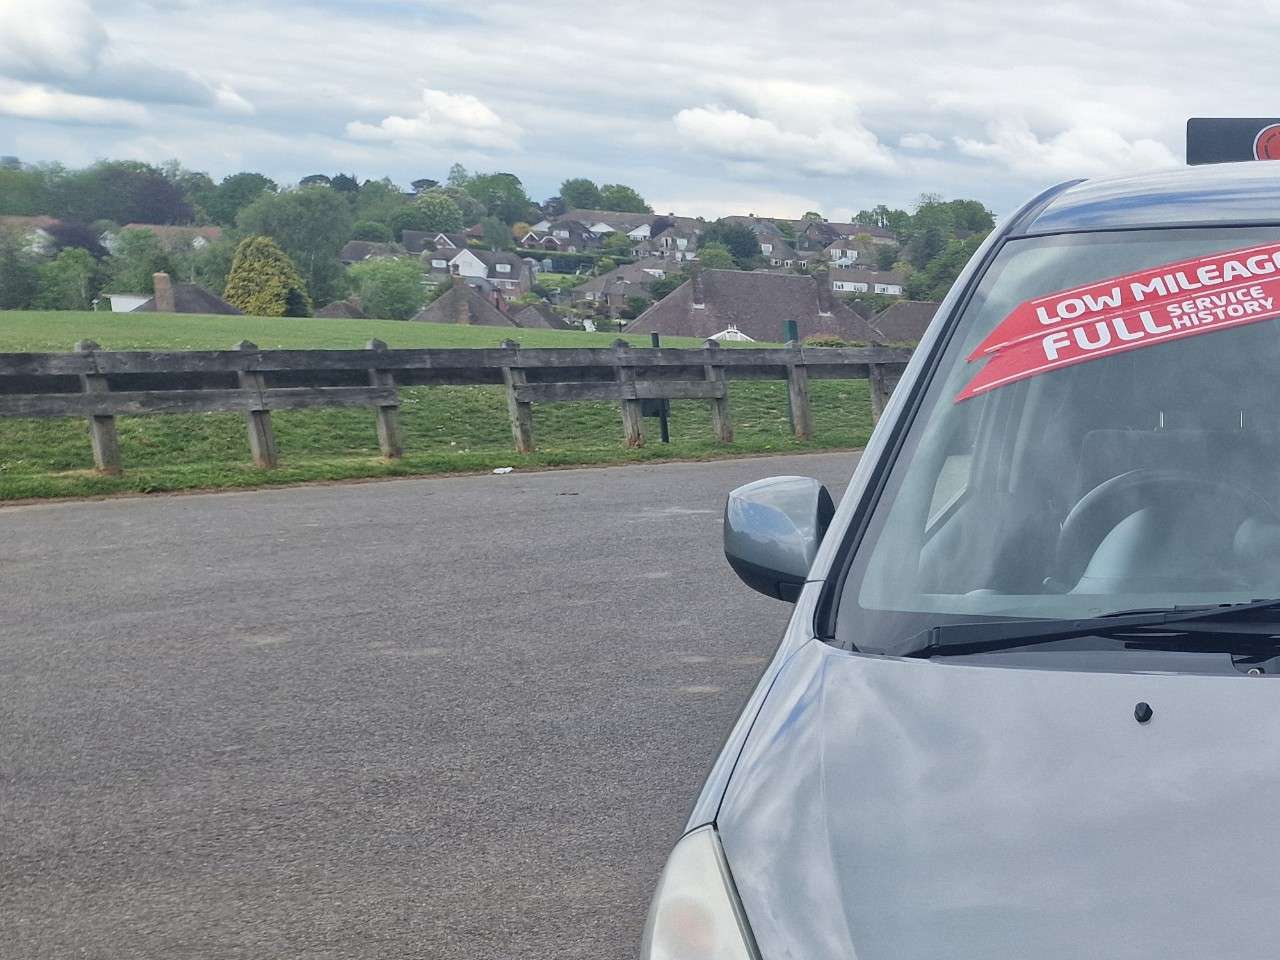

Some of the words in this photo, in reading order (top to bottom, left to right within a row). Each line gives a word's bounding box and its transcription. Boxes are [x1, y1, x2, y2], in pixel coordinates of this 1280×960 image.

[1036, 287, 1121, 325] LOW
[1166, 285, 1265, 317] SERVICE
[1171, 297, 1274, 329] HISTORY
[1042, 310, 1172, 361] FULL
